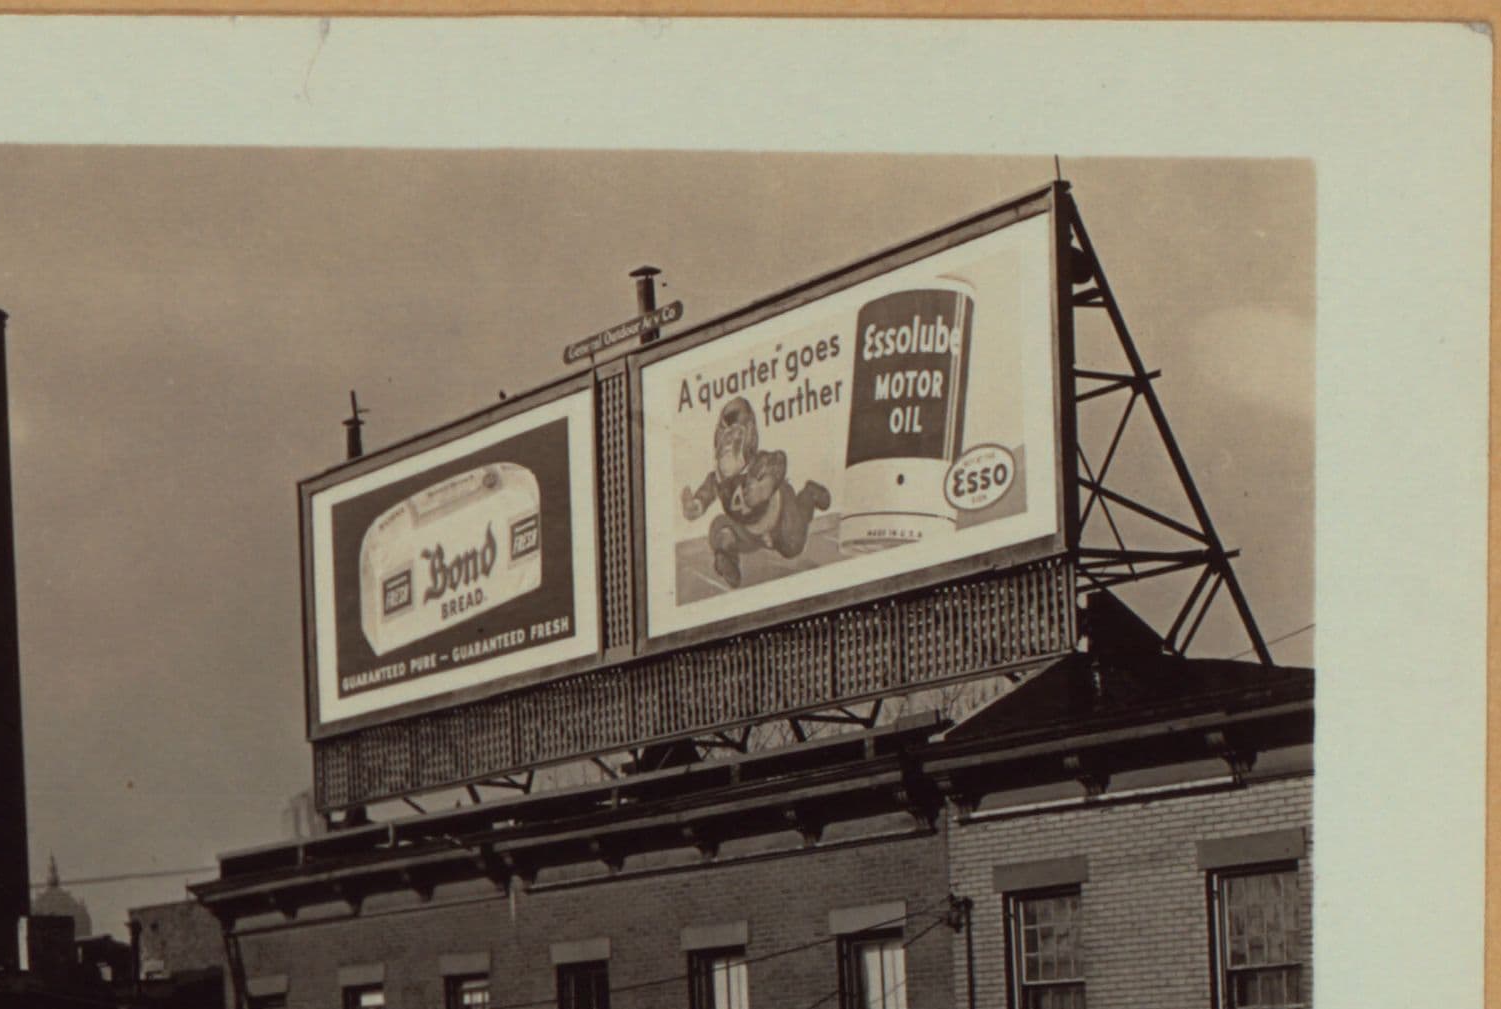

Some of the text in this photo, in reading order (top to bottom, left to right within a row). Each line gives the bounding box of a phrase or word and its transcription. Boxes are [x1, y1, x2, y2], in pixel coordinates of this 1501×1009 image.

[863, 314, 961, 361] Essolube
[678, 378, 693, 413] A
[785, 334, 841, 382] goes
[874, 369, 943, 401] MOTOR
[763, 377, 843, 427] farther
[889, 404, 923, 435] OIL
[420, 519, 497, 604] Bond
[441, 588, 484, 620] BREAD
[341, 662, 406, 692] GUARANTEED
[410, 653, 437, 670] PURE
[452, 629, 525, 663] GUARANTEED
[530, 616, 569, 641] FRESH
